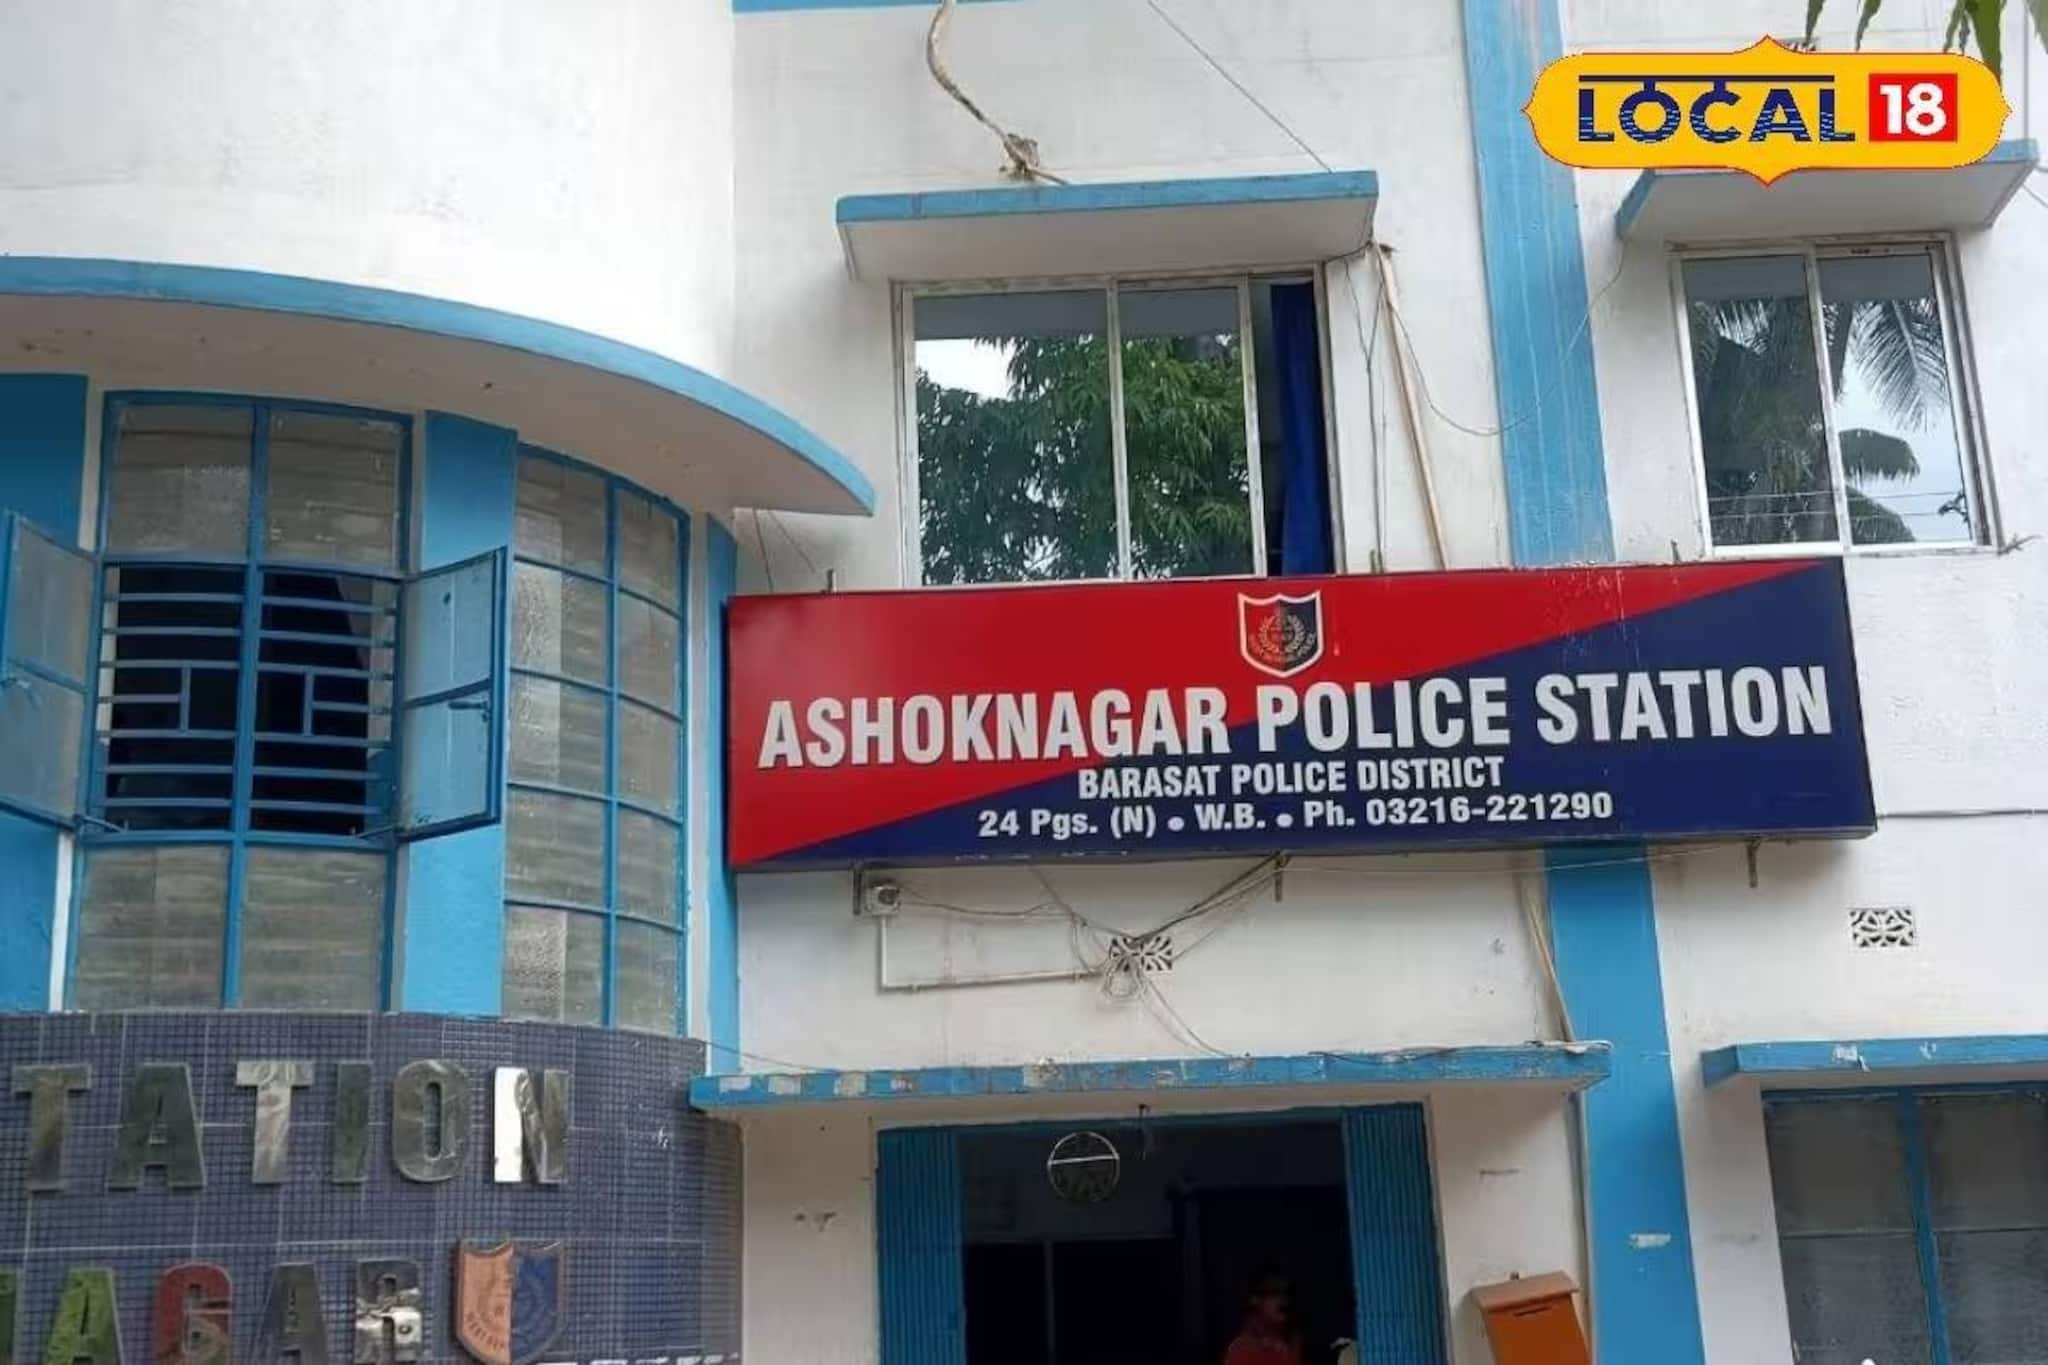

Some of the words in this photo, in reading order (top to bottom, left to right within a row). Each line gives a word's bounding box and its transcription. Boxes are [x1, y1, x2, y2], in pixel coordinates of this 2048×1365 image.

[757, 685, 1231, 769] ASHOKNAGAR
[1257, 676, 1511, 753] POLICE
[1535, 665, 1832, 745] STATION
[1078, 765, 1220, 799] BARASAT
[1231, 761, 1347, 796] POLICE
[1357, 756, 1505, 791] DISTRICT
[978, 809, 1020, 837] 24
[1030, 808, 1098, 840] Pgs.
[1109, 805, 1156, 838] (N)
[1194, 803, 1266, 831] W.B.
[1304, 800, 1355, 827] Ph.
[1366, 792, 1613, 825] 03216-221290
